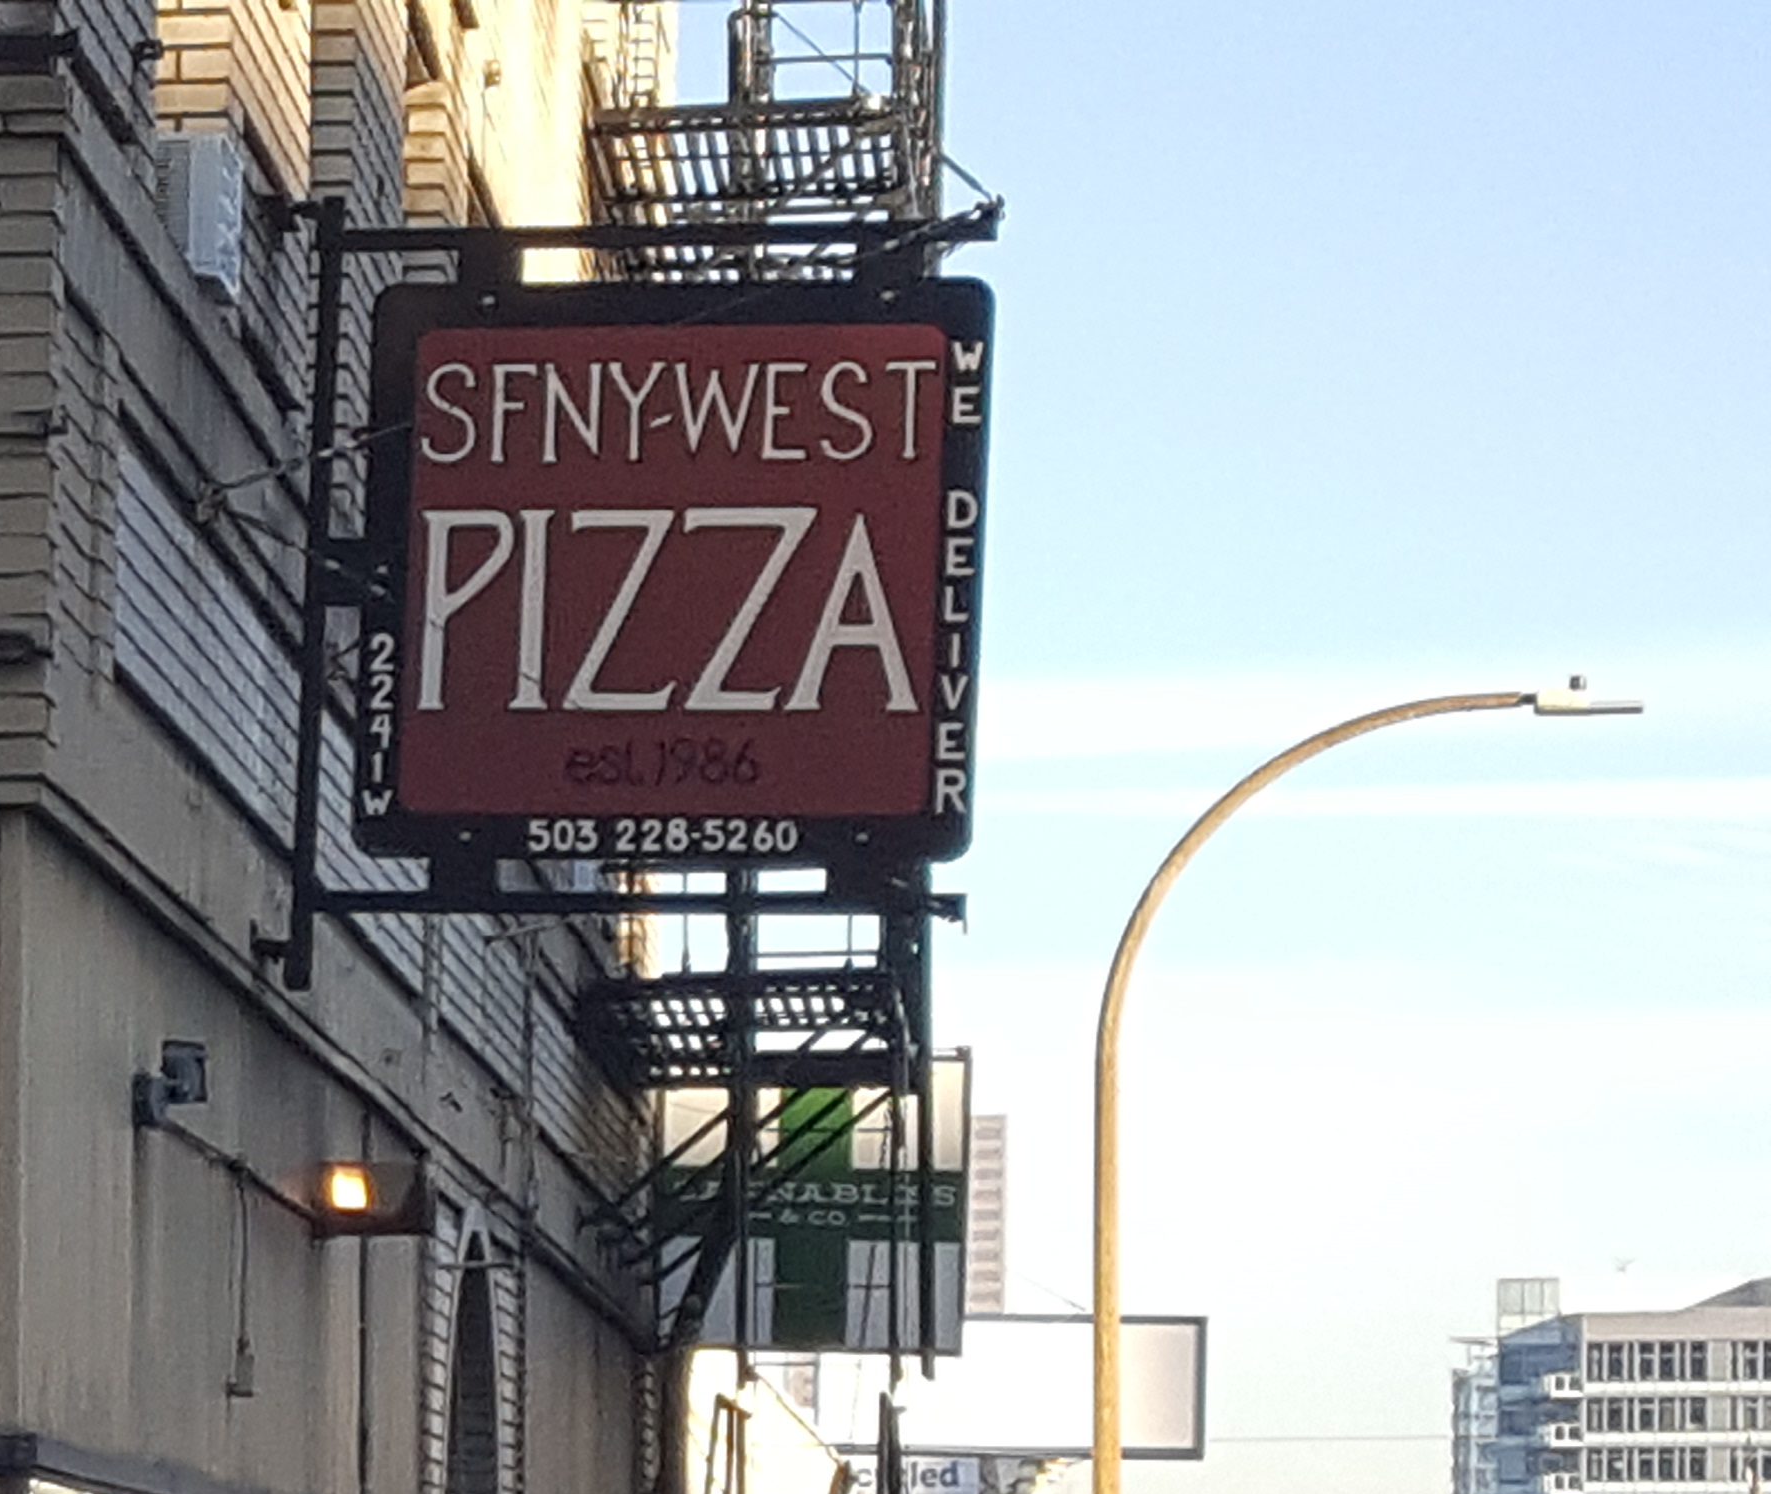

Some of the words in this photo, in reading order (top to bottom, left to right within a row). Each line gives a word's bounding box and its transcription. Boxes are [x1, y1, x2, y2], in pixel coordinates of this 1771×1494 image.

[950, 341, 984, 426] WE
[415, 507, 920, 712] PIZZA
[934, 491, 979, 815] DELIVER
[528, 819, 598, 853] 503
[615, 819, 800, 853] 228-5260
